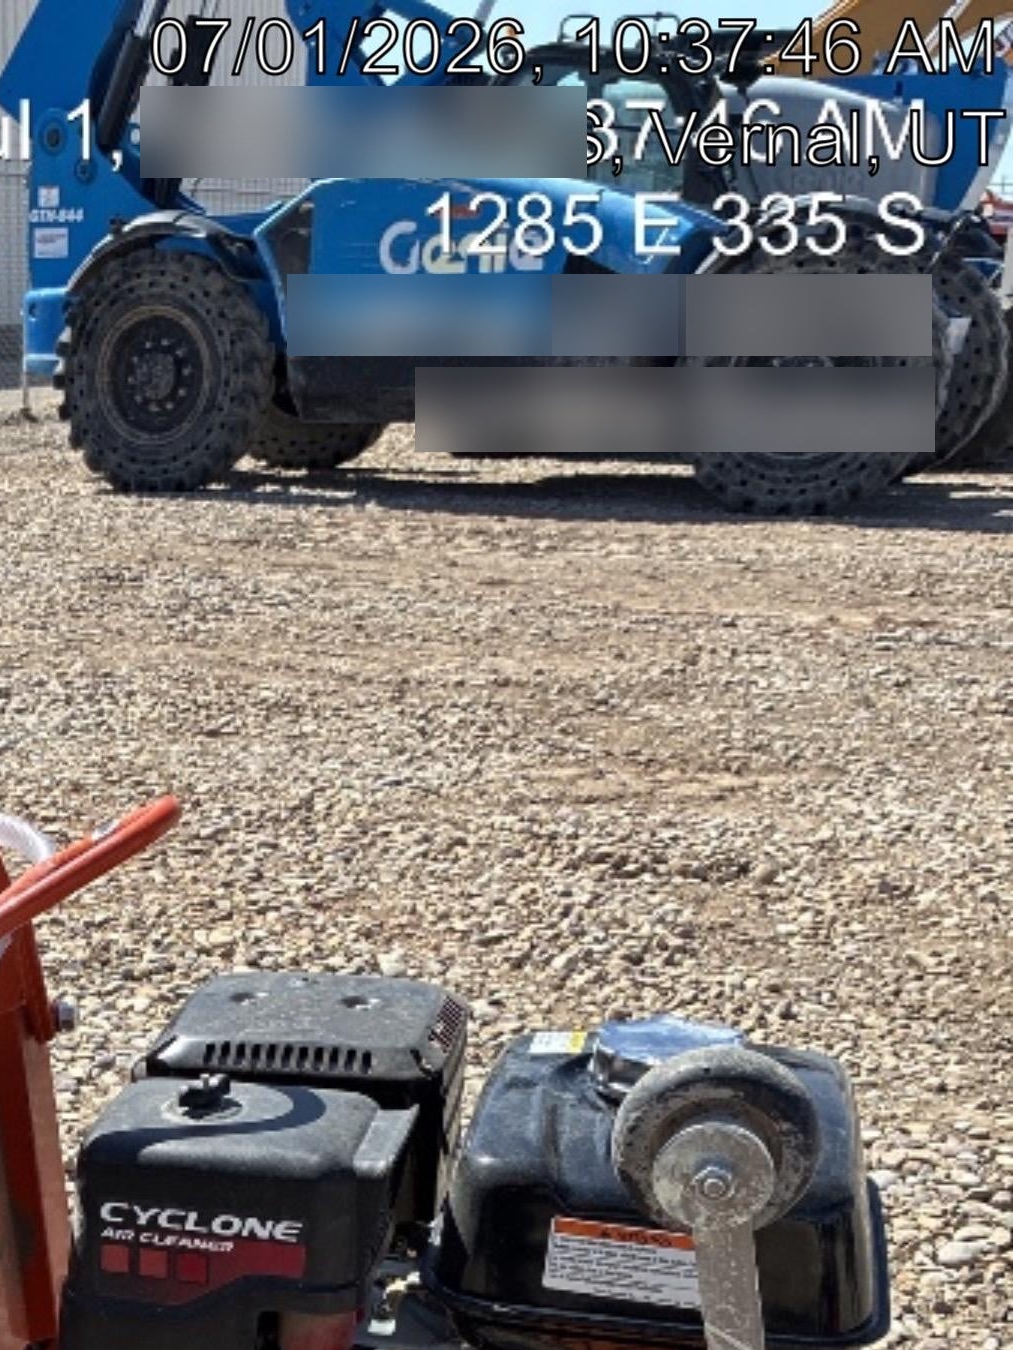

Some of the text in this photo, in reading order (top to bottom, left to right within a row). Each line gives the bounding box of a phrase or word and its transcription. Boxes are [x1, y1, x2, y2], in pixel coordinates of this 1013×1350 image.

[100, 1202, 303, 1243] CYCLONE
[101, 1226, 234, 1252] AIR CLEANER
